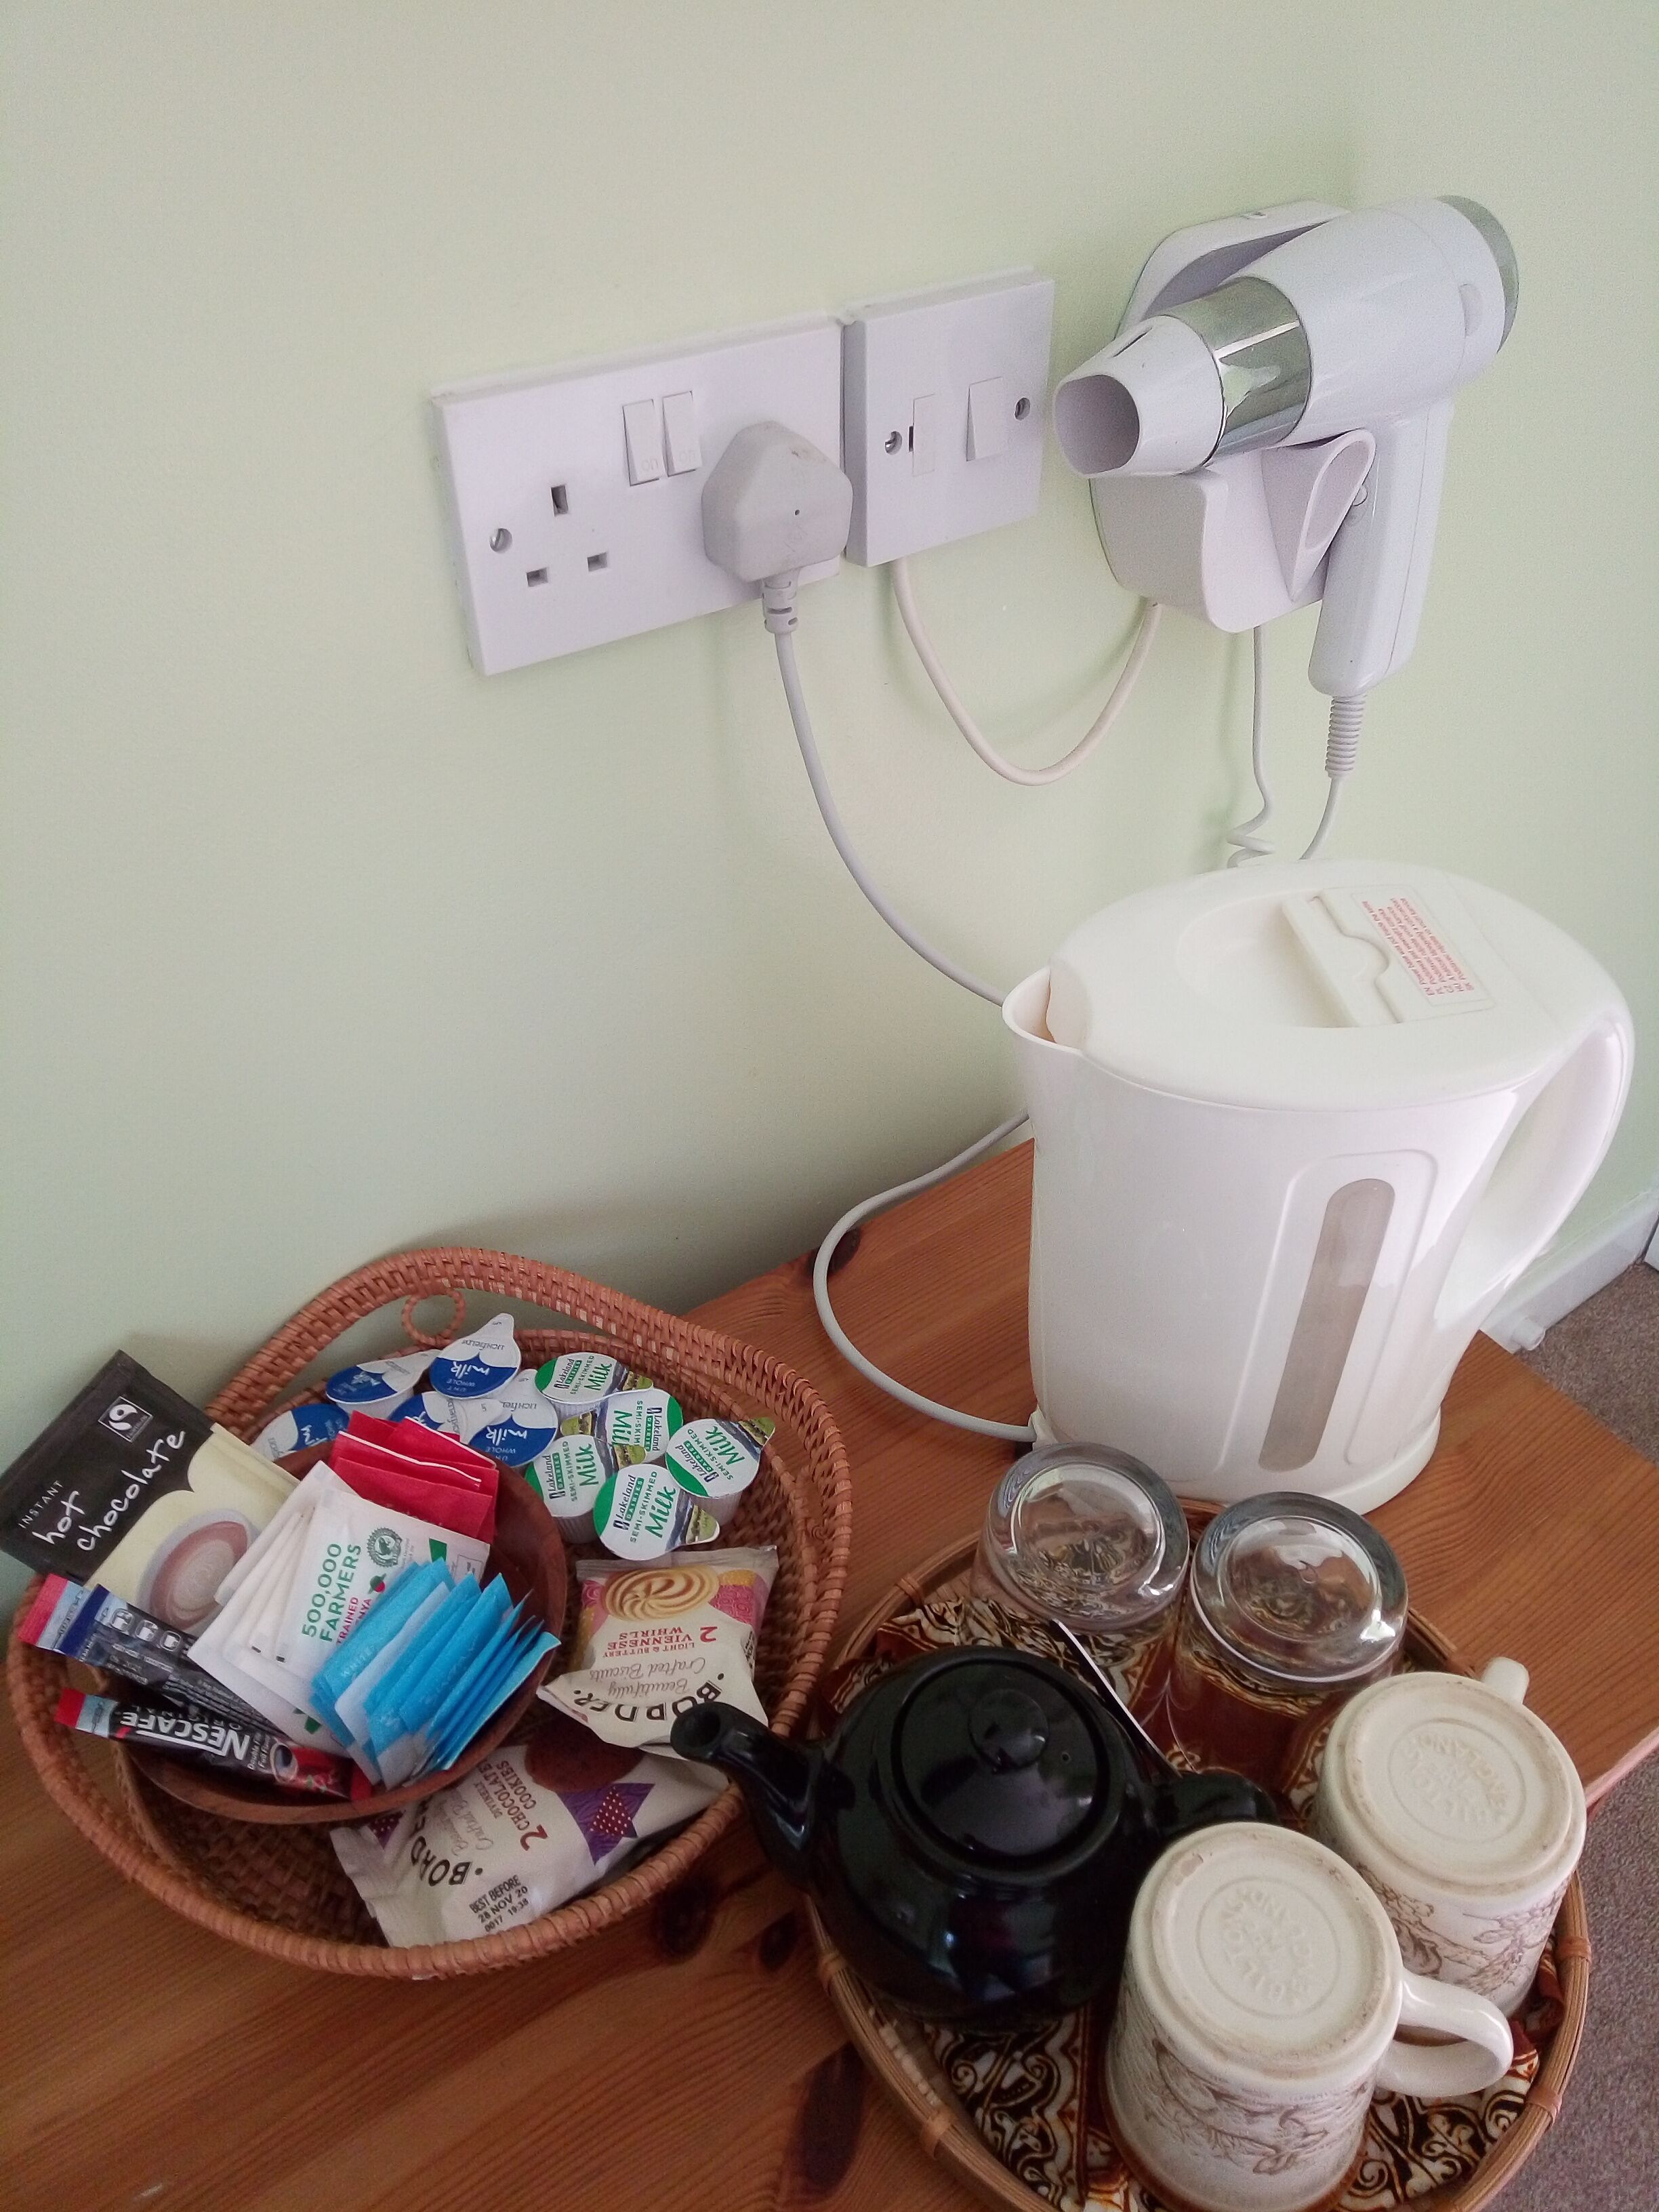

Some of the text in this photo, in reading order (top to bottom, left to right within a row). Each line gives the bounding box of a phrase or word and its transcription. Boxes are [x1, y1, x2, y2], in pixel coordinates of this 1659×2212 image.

[450, 1361, 490, 1379] milk
[559, 1358, 575, 1385] Lakeland
[583, 1363, 613, 1391] Milk
[486, 1426, 528, 1446] milk
[611, 1410, 633, 1446] Mil
[634, 1400, 643, 1446] SEMI-SKIM
[652, 1415, 662, 1451] Lakeland
[675, 1444, 707, 1478] Lakeland
[687, 1428, 734, 1480] SEMI-SKIMMED
[705, 1425, 745, 1465] Milk
[543, 1455, 556, 1492] Lakeland
[562, 1441, 577, 1502] SEMI-SKIMMED
[575, 1443, 599, 1486] Milk
[18, 1479, 63, 1529] INSTANT
[76, 1430, 186, 1551] chocolate
[615, 1474, 636, 1519] Lakeland
[630, 1471, 657, 1543] SEMI-SKIMMED
[31, 1490, 86, 1544] hot
[645, 1486, 676, 1538] Milk
[302, 1542, 342, 1638] 500,000
[320, 1543, 362, 1643] FARMERS
[607, 1633, 693, 1650] VIENNESE
[619, 1626, 683, 1640] WHIRLS
[665, 1641, 695, 1652] LIGHT
[700, 1626, 718, 1643] 2
[589, 1657, 706, 1680] Crafted Biscuits
[602, 1647, 650, 1658] BUTTERY
[607, 1678, 689, 1696] Beautifully
[495, 1759, 537, 1810] COOKIES
[517, 1824, 548, 1851] 2
[469, 1875, 520, 1913] BEST BEFORE
[491, 1894, 512, 1914] NOV
